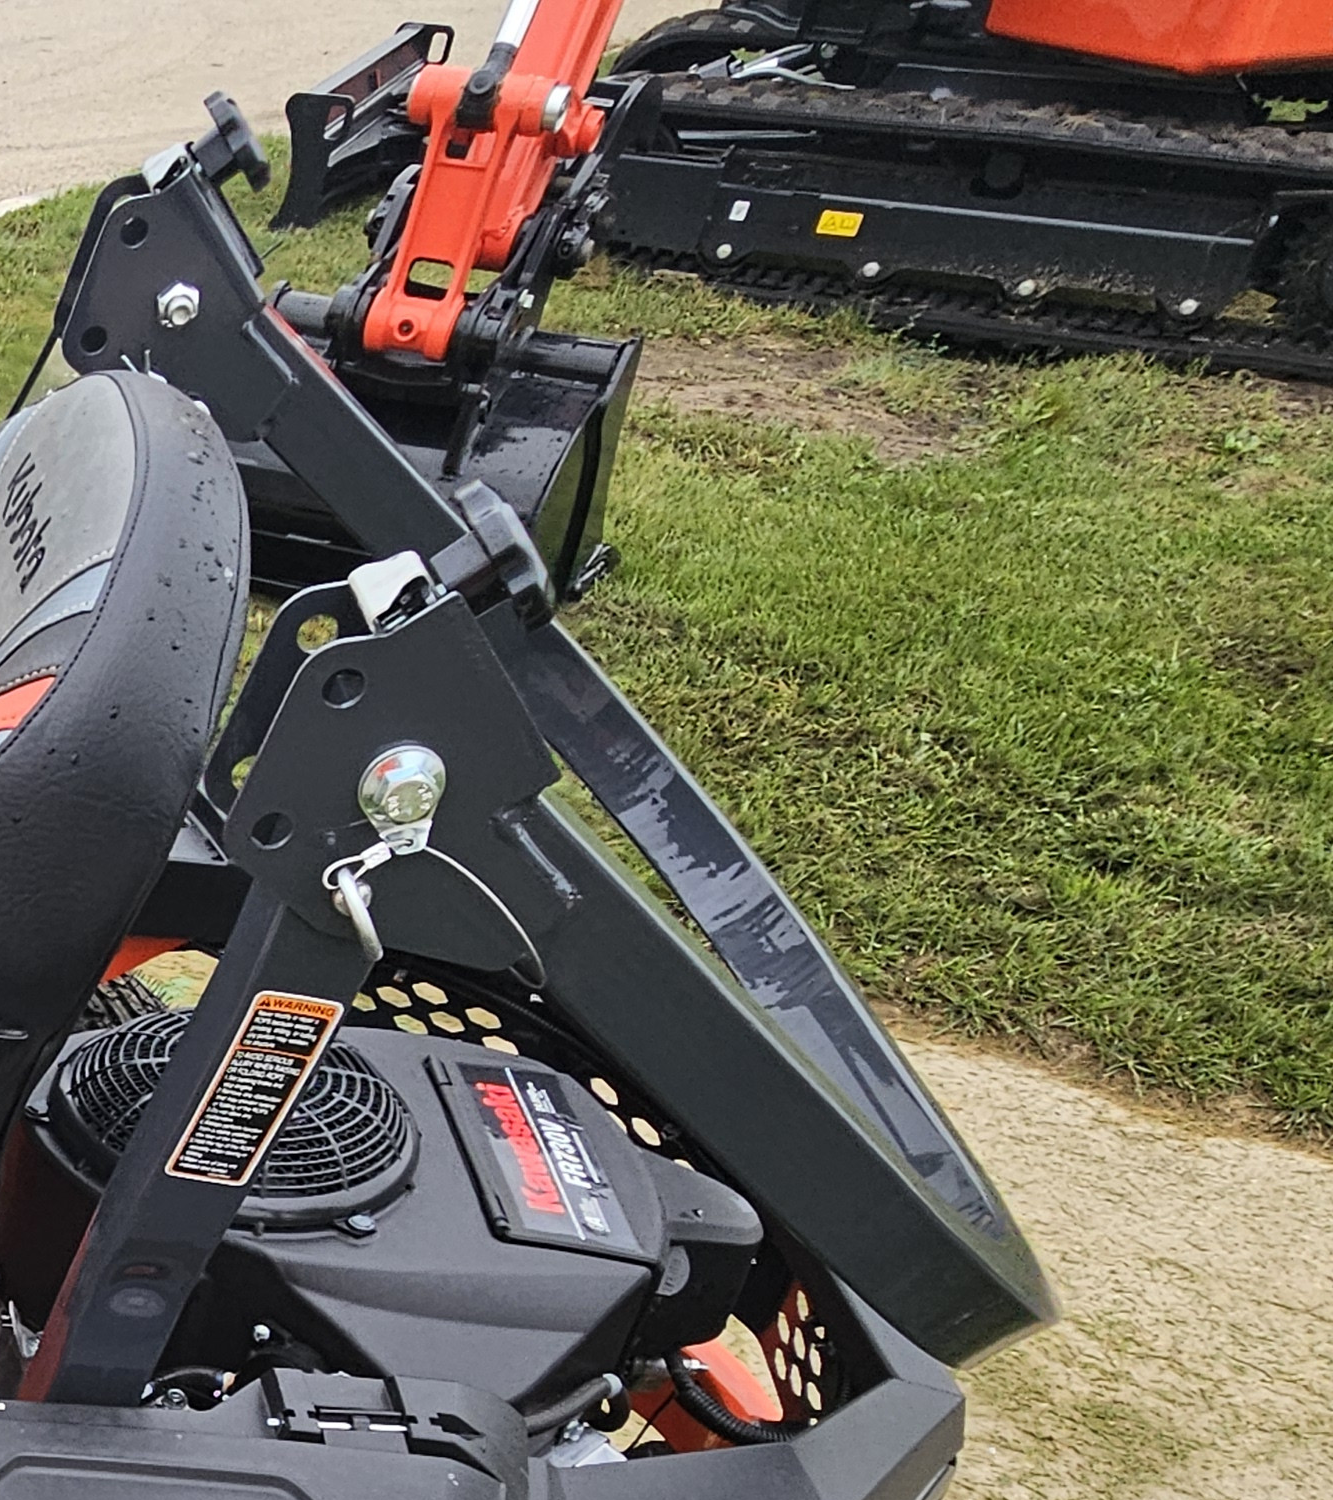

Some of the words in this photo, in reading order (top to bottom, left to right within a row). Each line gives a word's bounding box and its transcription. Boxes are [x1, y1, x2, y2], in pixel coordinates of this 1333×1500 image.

[3, 452, 51, 594] Kubota
[273, 999, 336, 1018] WARNING
[474, 1082, 566, 1214] Kawasaki
[537, 1117, 593, 1190] FR730V
